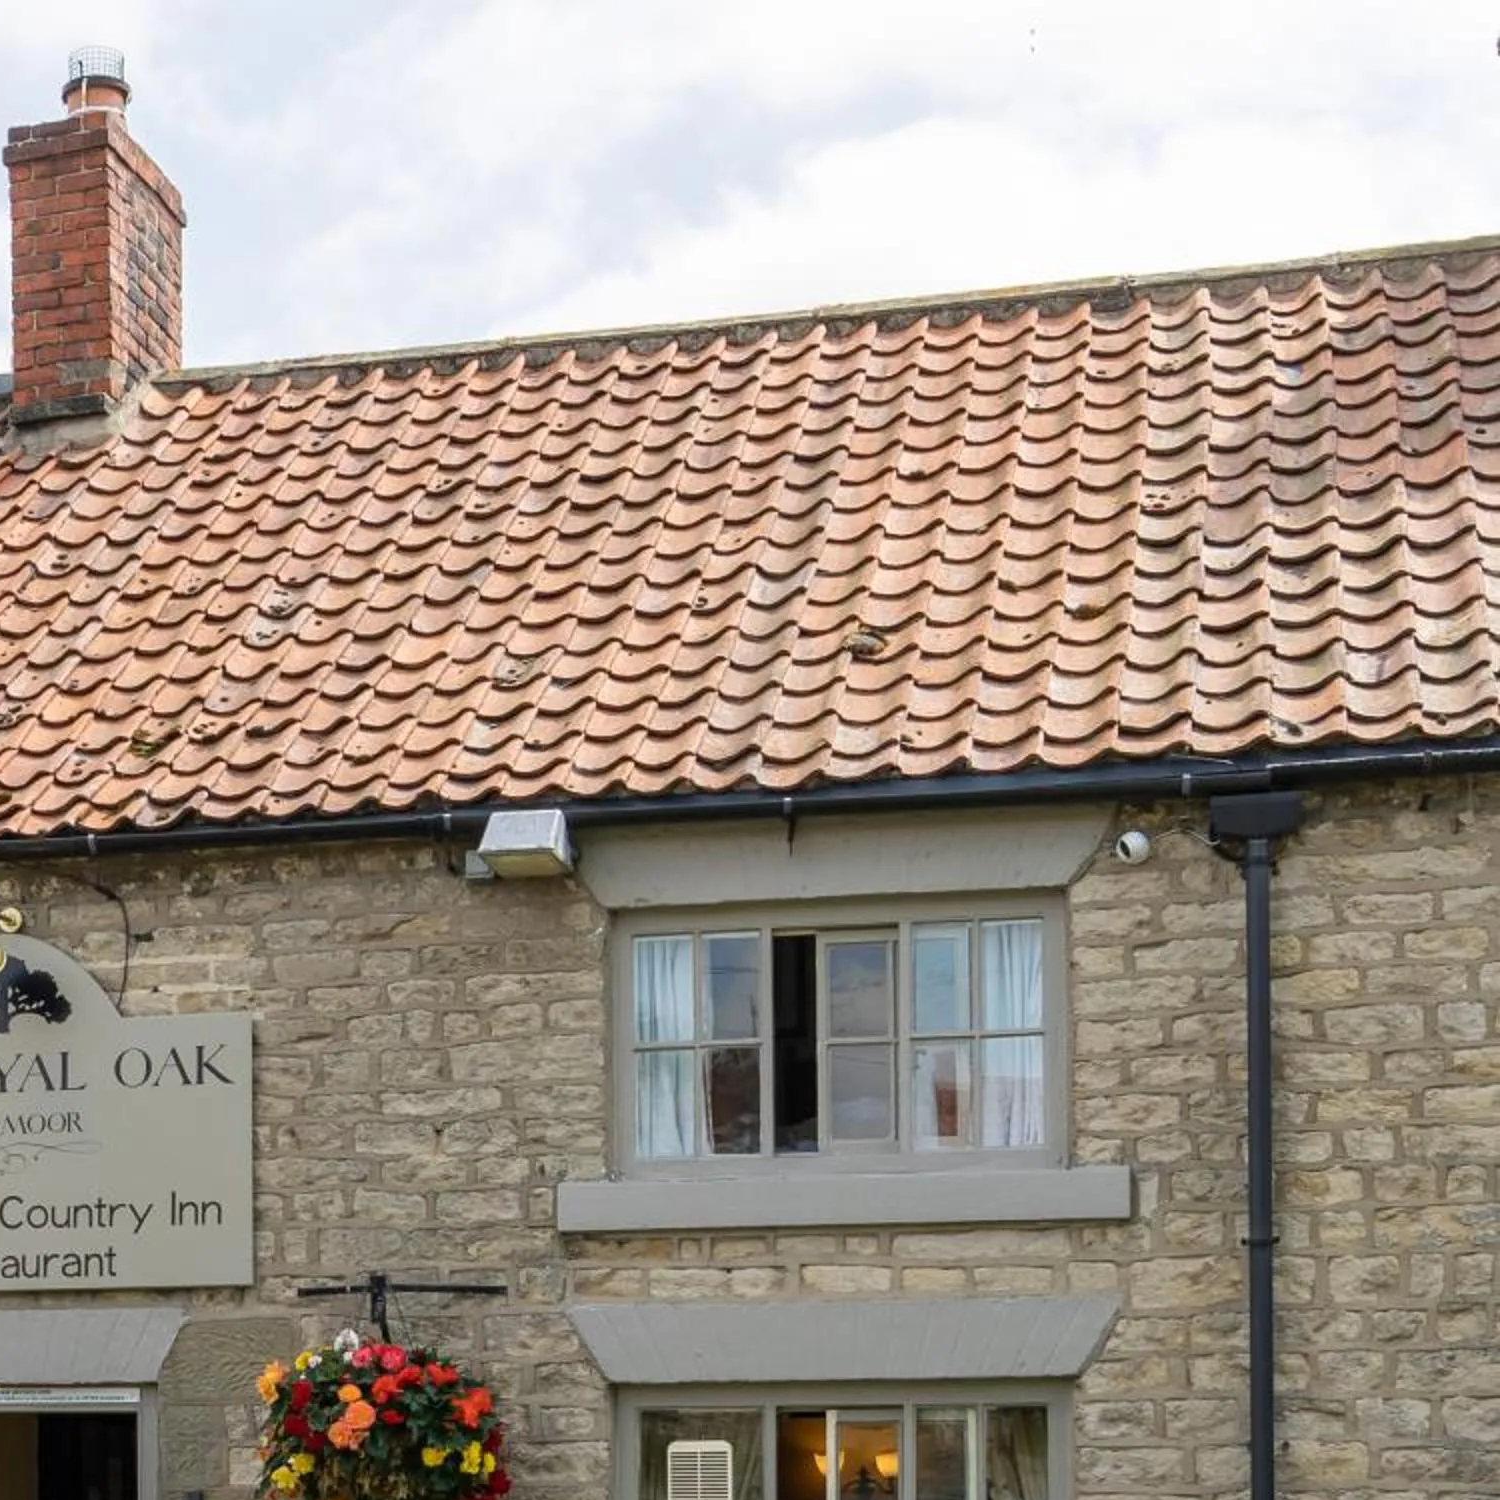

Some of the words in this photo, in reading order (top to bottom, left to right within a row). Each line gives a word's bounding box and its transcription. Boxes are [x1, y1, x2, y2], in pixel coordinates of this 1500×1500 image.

[114, 1044, 234, 1088] OAK
[0, 1195, 153, 1234] Country
[171, 1191, 222, 1227] Inn
